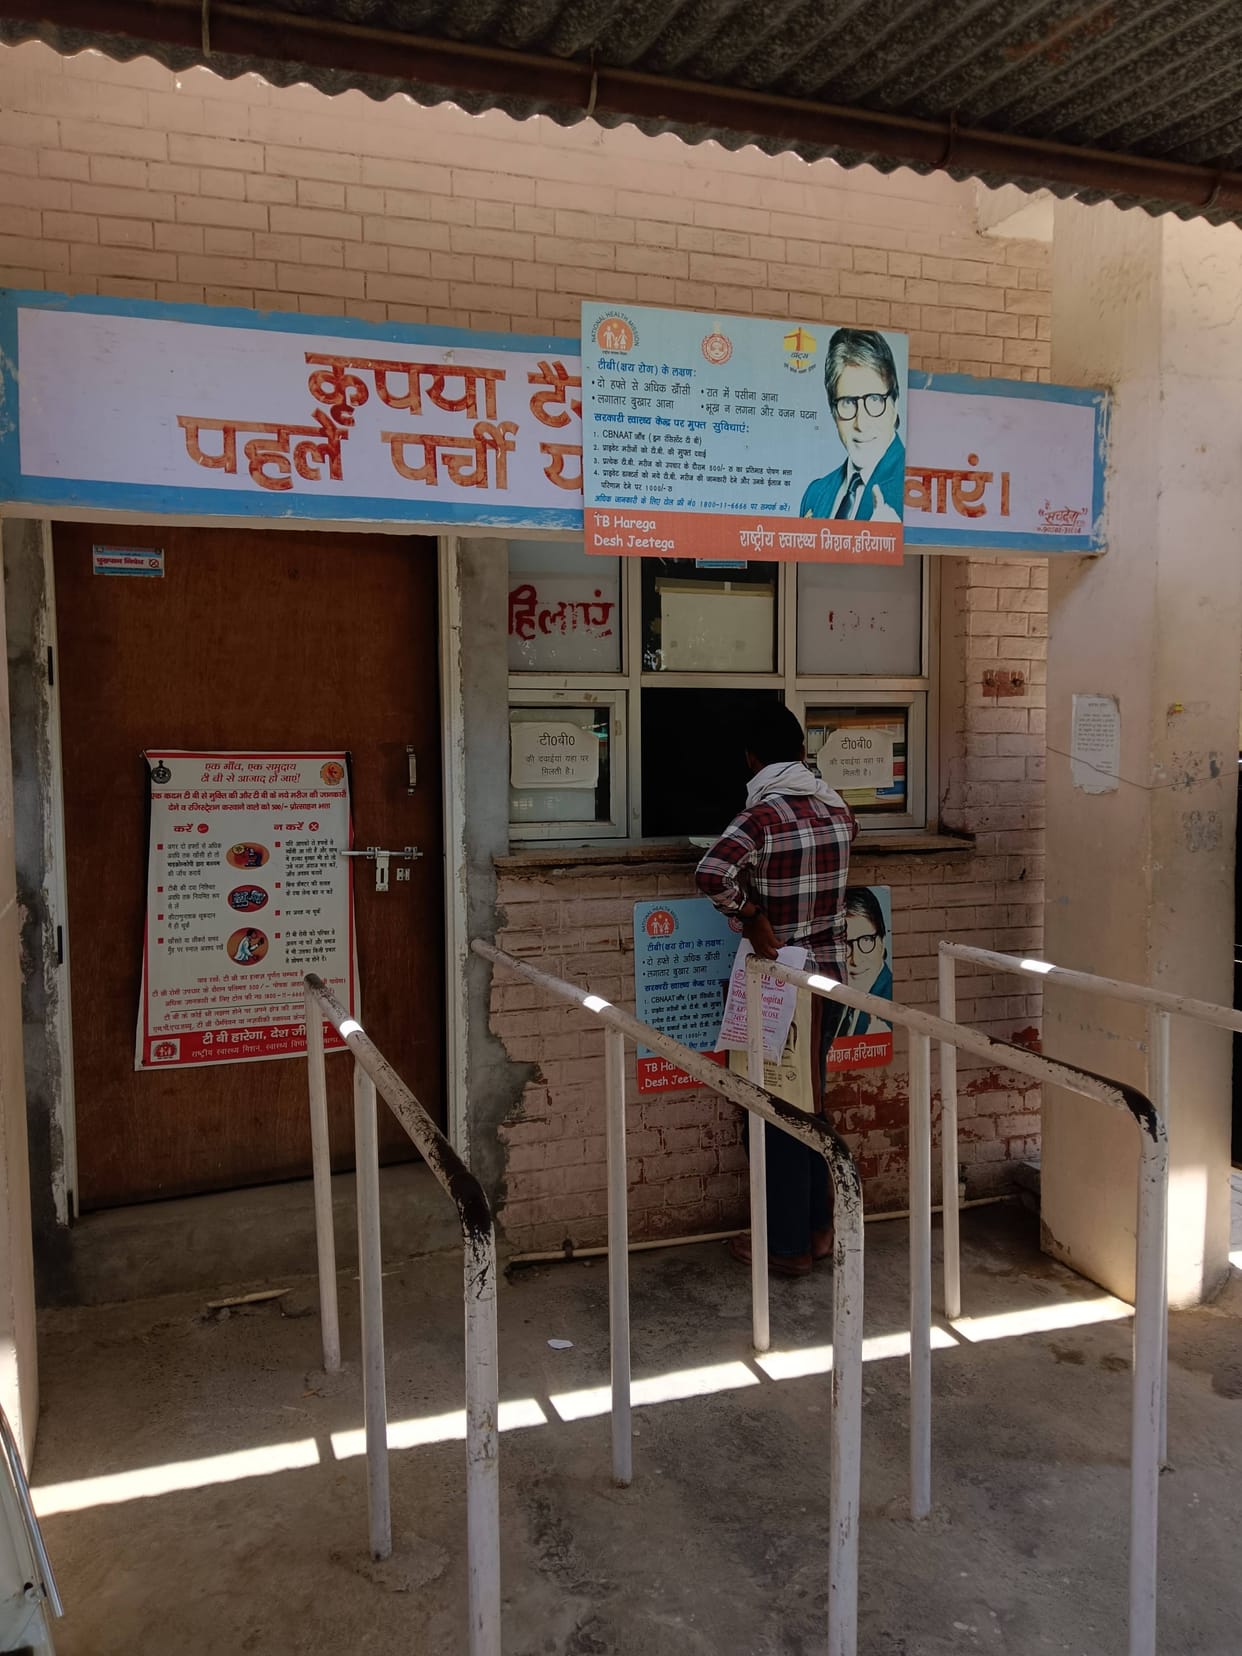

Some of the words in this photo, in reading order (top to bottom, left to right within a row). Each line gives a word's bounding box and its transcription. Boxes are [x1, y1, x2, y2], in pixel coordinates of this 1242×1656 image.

[661, 363, 669, 376] के
[305, 352, 505, 426] कृपया
[527, 360, 582, 428] टै
[596, 376, 605, 389] दो
[632, 378, 639, 391] से
[644, 380, 667, 393] अधिक
[597, 394, 627, 406] लगातार
[630, 396, 652, 409] बुखार
[656, 399, 674, 409] आना
[706, 388, 718, 398] रात
[735, 388, 756, 401] पसीना
[761, 392, 779, 402] आना
[594, 412, 624, 423] सरकारी
[724, 405, 730, 413] न
[735, 405, 756, 415] लगना
[760, 405, 774, 416] और
[602, 430, 633, 440] CBNAAT
[178, 408, 348, 490] पहले
[381, 420, 519, 490] पर्ची
[594, 512, 610, 527] TB
[614, 515, 656, 532] Harega
[594, 534, 623, 547] Desh
[627, 535, 674, 551] Jeetega
[739, 525, 775, 551] राष्ट्रीय
[778, 532, 817, 549] स्वास्थ्य
[226, 773, 235, 782] से
[269, 772, 278, 783] हो
[202, 1032, 214, 1044] टी
[271, 1027, 288, 1038] देश
[645, 1076, 668, 1088] Desh
